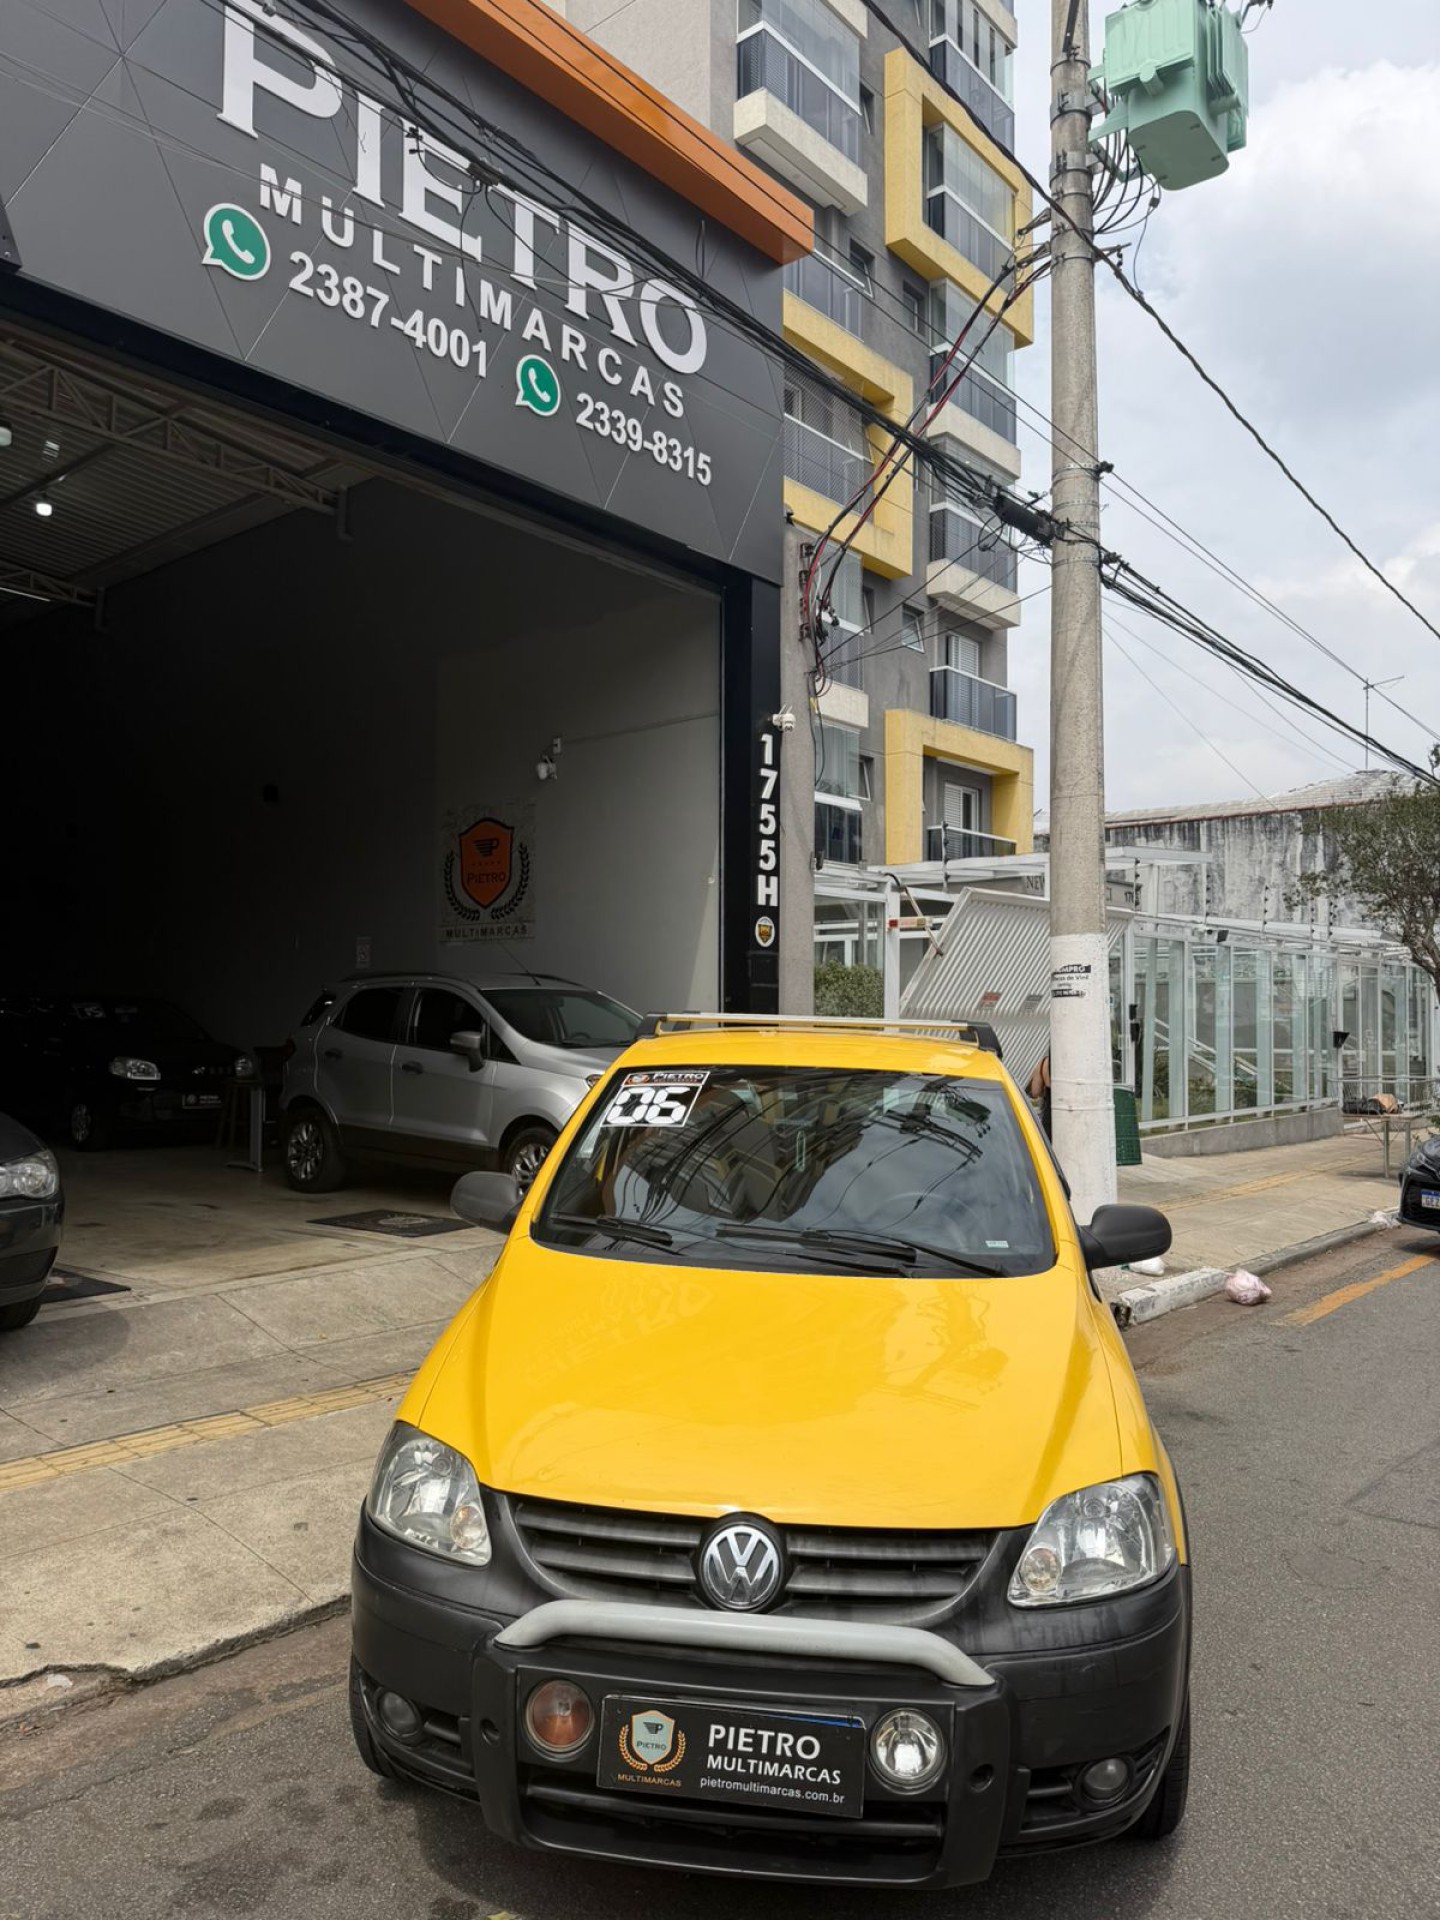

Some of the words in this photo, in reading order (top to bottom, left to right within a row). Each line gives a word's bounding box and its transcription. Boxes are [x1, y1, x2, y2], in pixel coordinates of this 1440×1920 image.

[217, 0, 708, 374] PIETRO
[260, 163, 684, 418] MULTIMARCAS
[289, 251, 487, 379] 2387-4001
[576, 393, 712, 486] 2339-8315
[757, 733, 778, 907] 1755H
[467, 872, 507, 885] PIETRO
[446, 924, 528, 938] MULTIMARCAS
[606, 1086, 691, 1124] 06
[708, 1723, 821, 1760] PIETRO
[617, 1773, 682, 1787] MULTIMARCAS
[706, 1754, 842, 1785] MULTIMARCAS
[700, 1775, 845, 1804] pietromultimarcas.com.br
